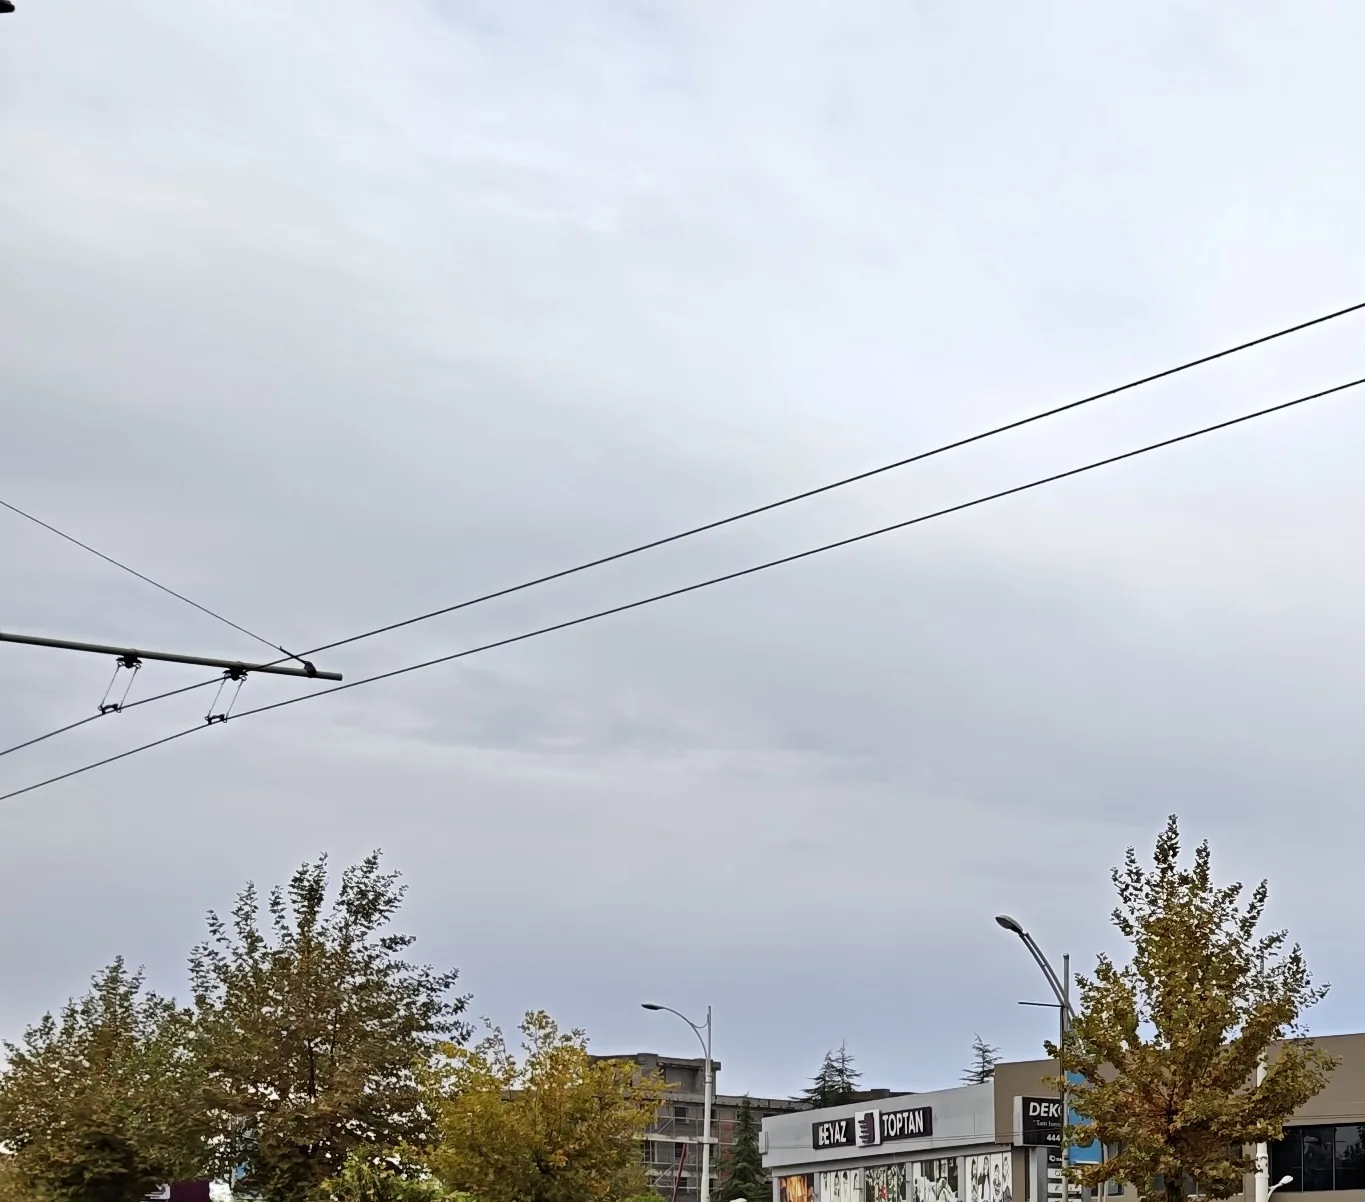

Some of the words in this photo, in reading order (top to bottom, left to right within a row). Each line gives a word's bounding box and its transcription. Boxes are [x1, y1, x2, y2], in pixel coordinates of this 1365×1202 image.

[1029, 1102, 1061, 1117] DEK
[818, 1120, 847, 1145] BEYAZ
[882, 1110, 924, 1137] TOPTAN
